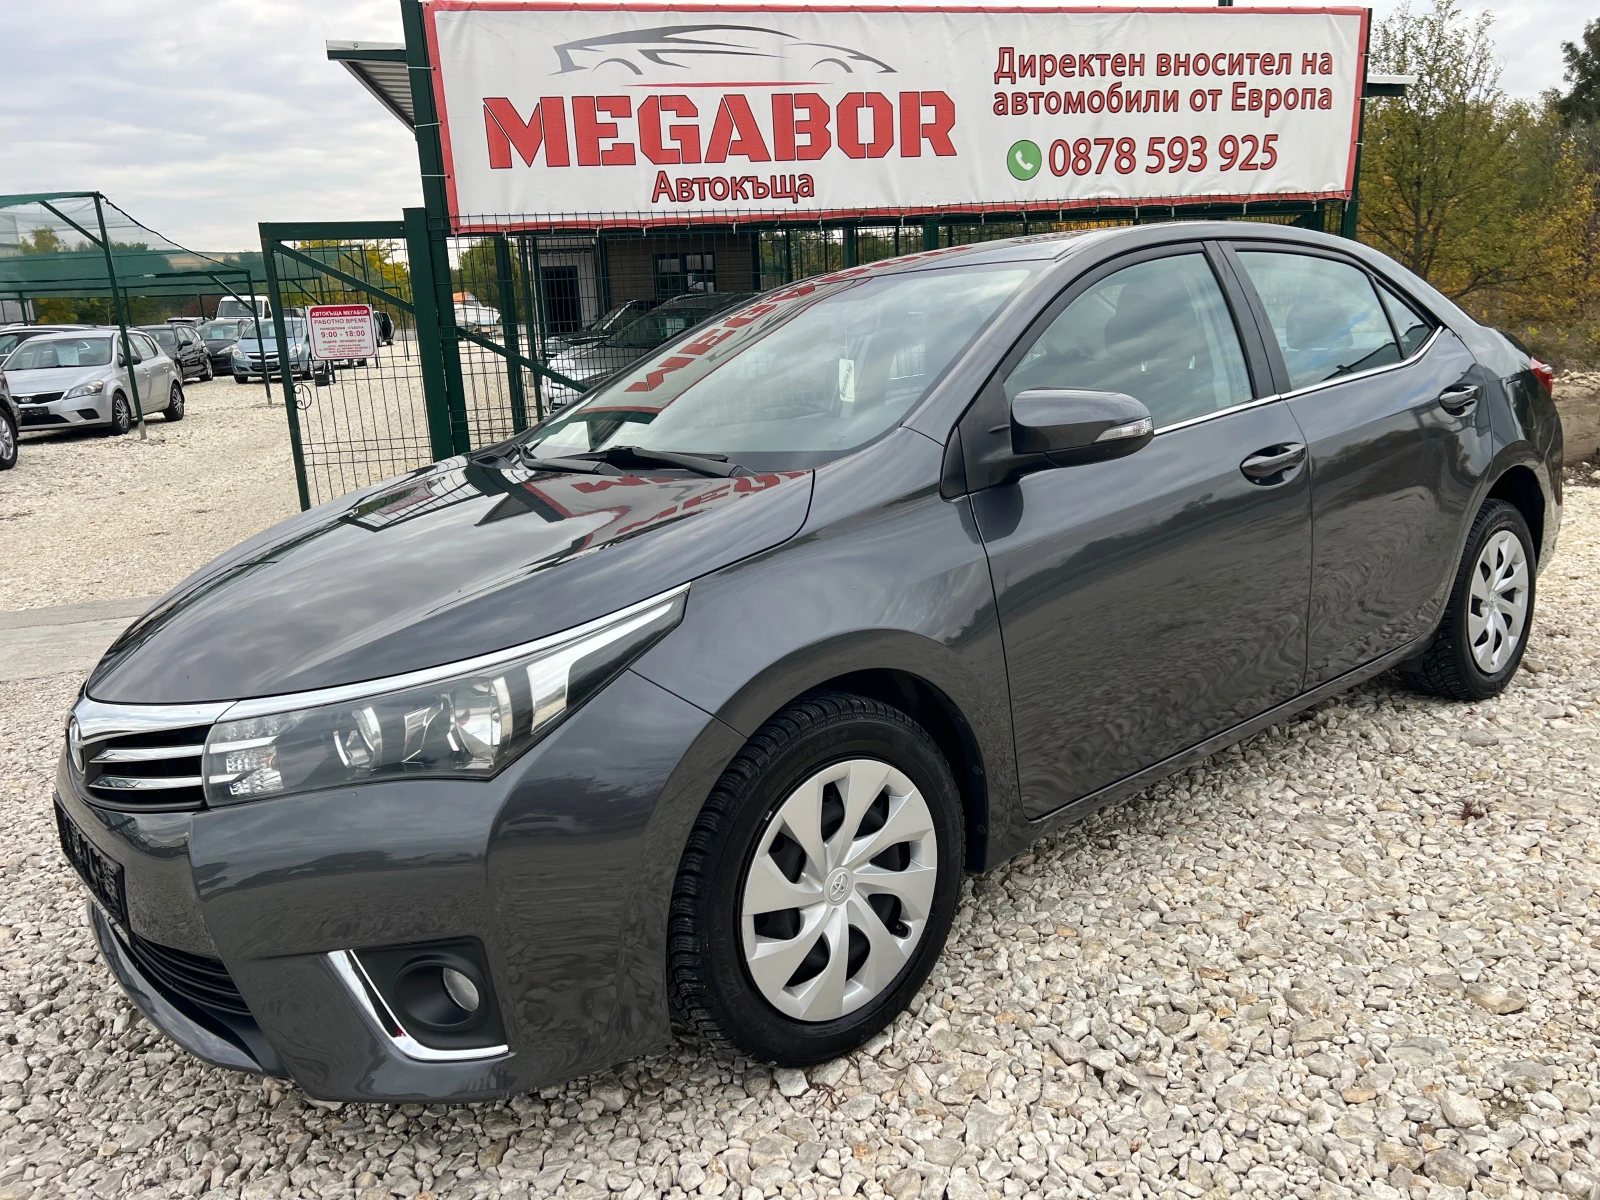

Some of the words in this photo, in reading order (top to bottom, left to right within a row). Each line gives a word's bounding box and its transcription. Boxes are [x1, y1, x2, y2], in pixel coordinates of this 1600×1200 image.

[994, 47, 1146, 85] Директен
[1156, 52, 1292, 77] вносител
[1301, 52, 1333, 76] на
[993, 81, 1180, 117] автомобили
[1189, 89, 1223, 112] от
[1231, 82, 1333, 118] Европа
[483, 91, 958, 169] MEGABOR
[1048, 137, 1137, 177] 0878
[1145, 135, 1208, 174] 593
[1218, 133, 1279, 172] 925
[652, 171, 815, 205] Автокъща
